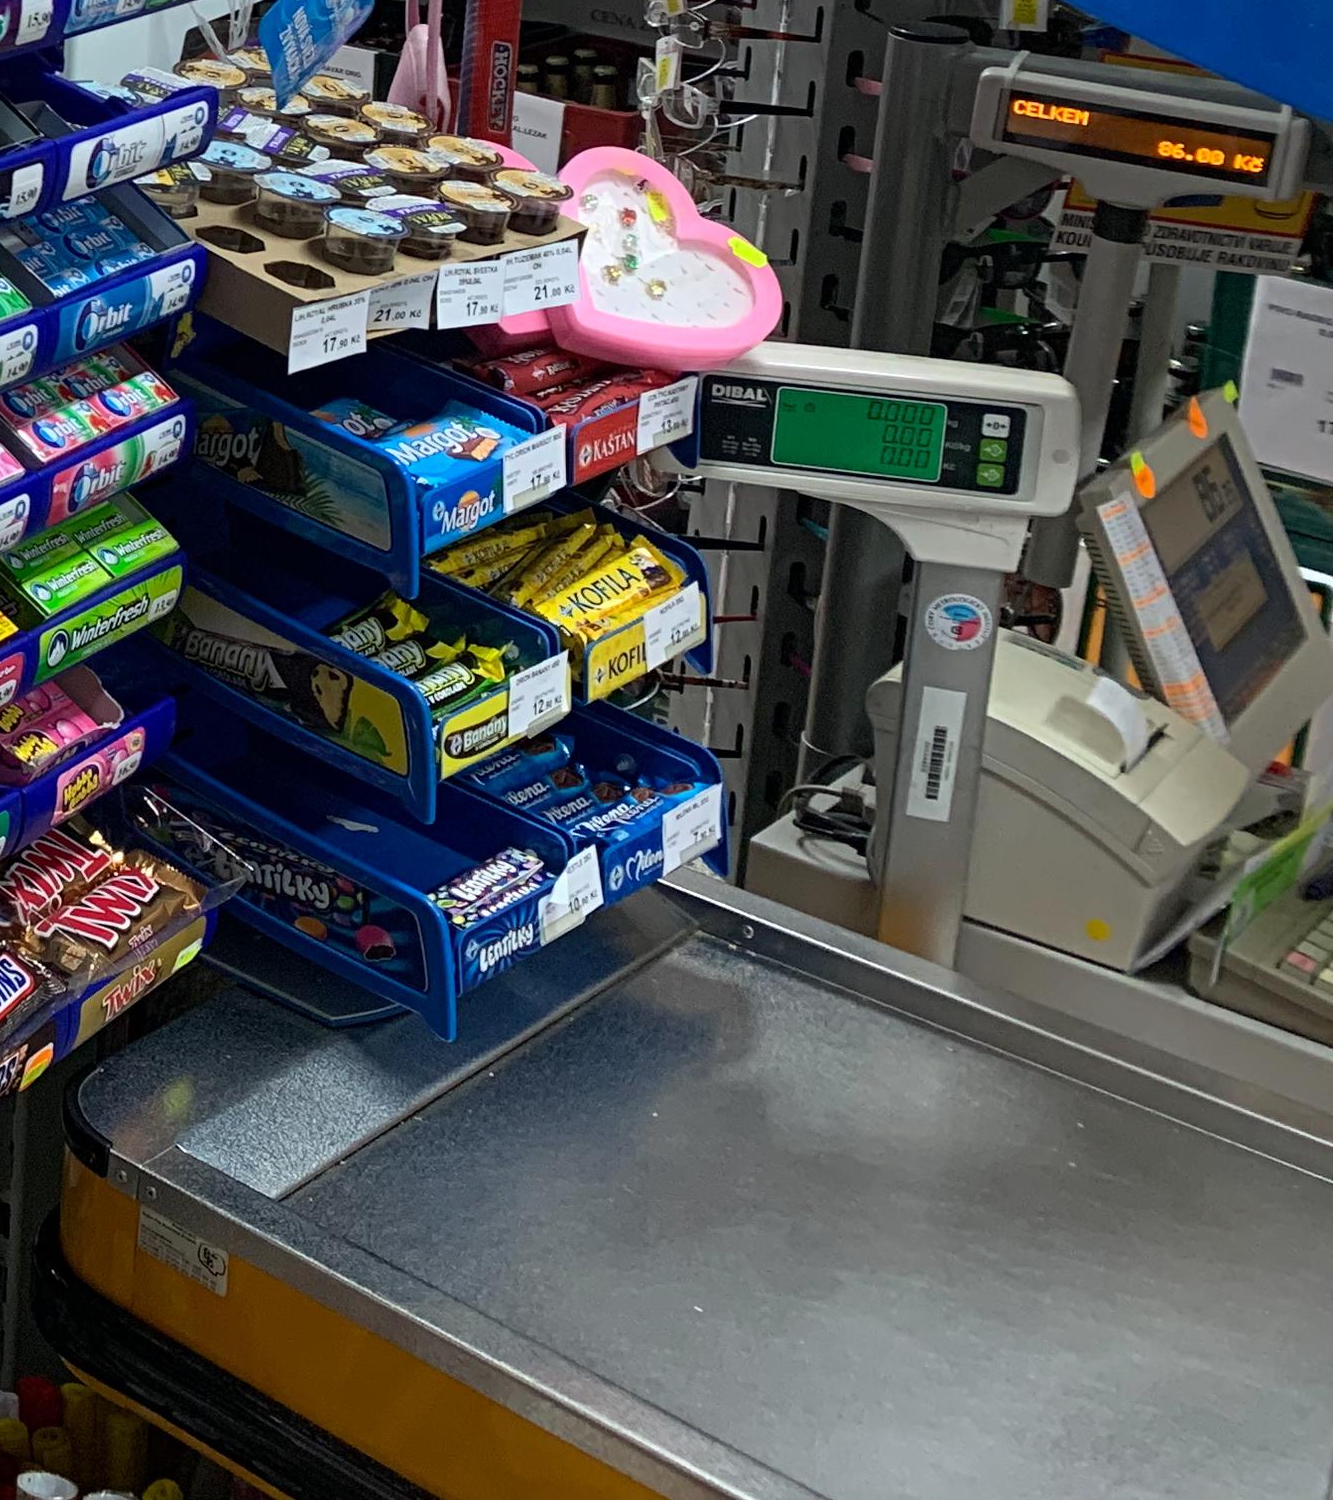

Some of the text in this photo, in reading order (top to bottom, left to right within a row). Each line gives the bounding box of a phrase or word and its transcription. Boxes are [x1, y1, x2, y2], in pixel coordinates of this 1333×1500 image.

[489, 42, 513, 131] HOCKEY
[1013, 99, 1090, 127] CELKEM
[86, 136, 147, 189] Orbit
[1233, 153, 1265, 173] Kč
[564, 283, 575, 294] Kč
[75, 300, 135, 351] Orbit
[409, 308, 422, 319] Kč
[351, 333, 361, 344] Kč
[710, 382, 768, 402] DIBAL
[32, 416, 83, 450] Orbit
[389, 422, 486, 468] Margot
[591, 427, 635, 462] KAŠTAN
[68, 461, 126, 514] Orbit
[441, 490, 496, 534] Margot
[113, 528, 166, 558] Winterfresh
[567, 568, 641, 617] KOFILA
[70, 595, 150, 653] Winterfresh
[182, 626, 286, 690] Banany
[607, 643, 646, 680] KOFIL
[462, 713, 508, 747] Banany
